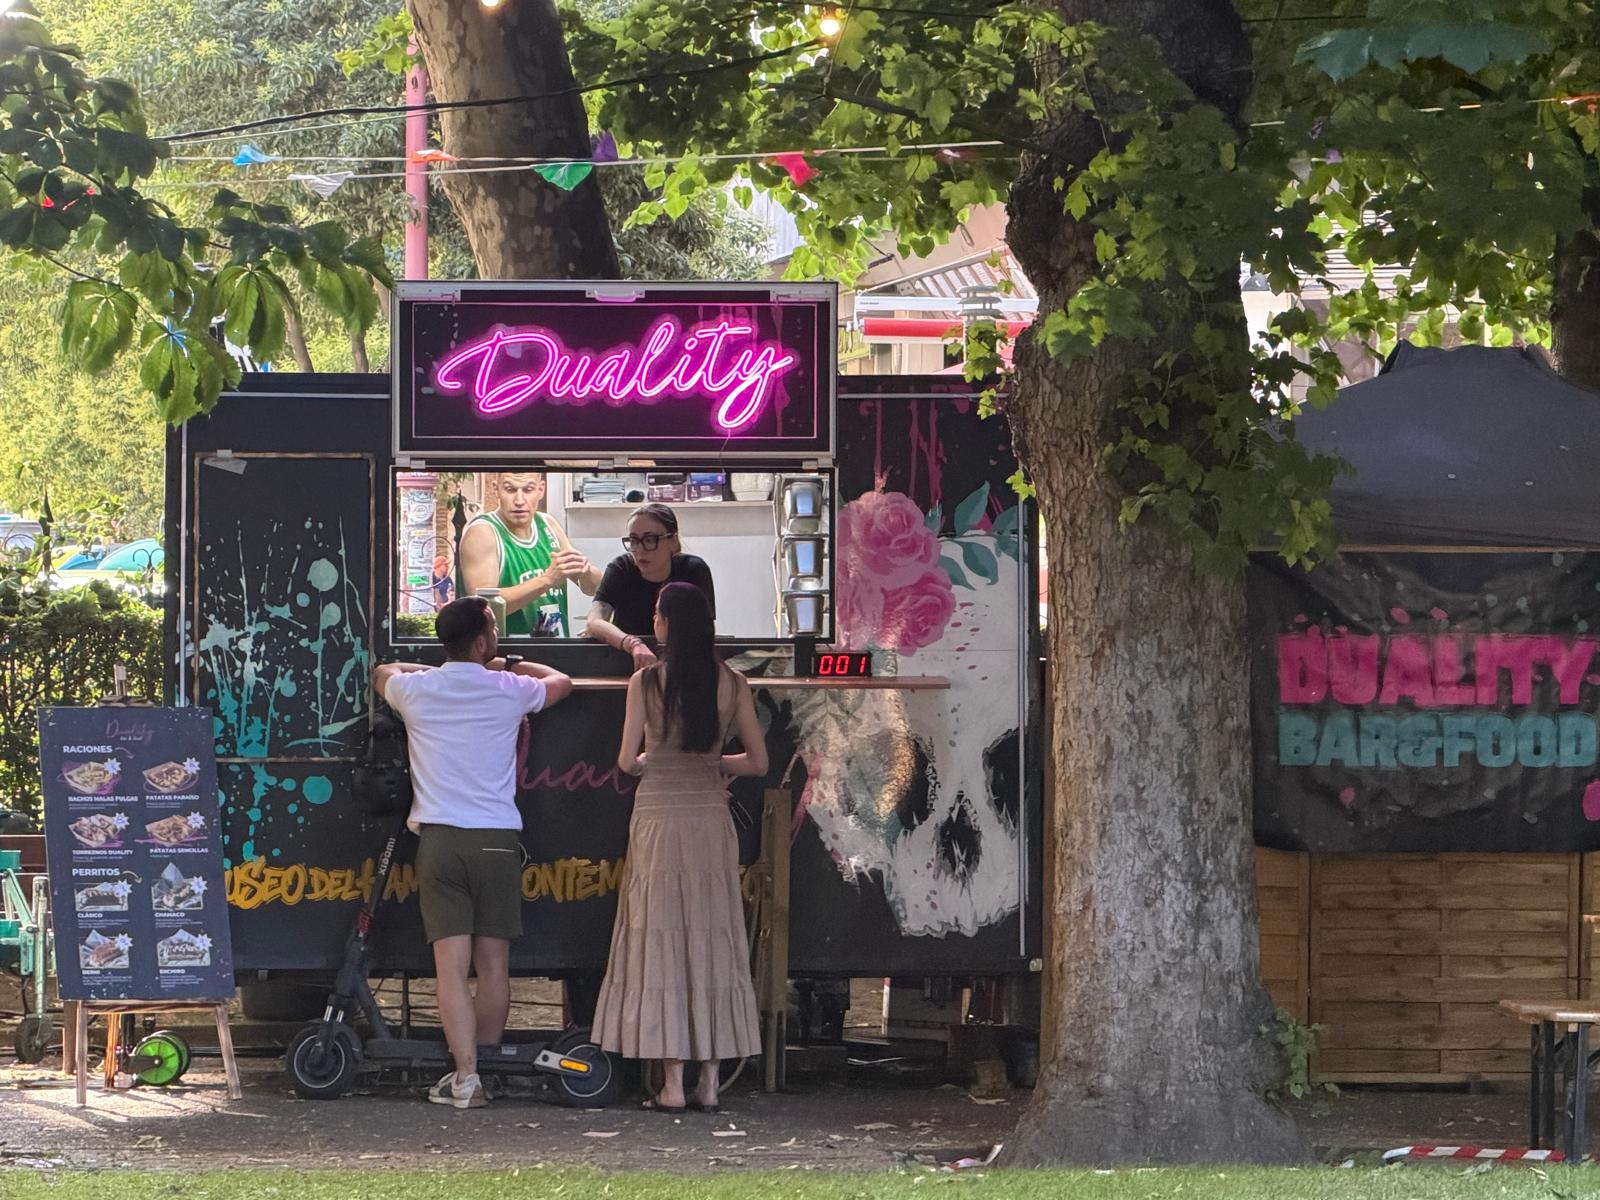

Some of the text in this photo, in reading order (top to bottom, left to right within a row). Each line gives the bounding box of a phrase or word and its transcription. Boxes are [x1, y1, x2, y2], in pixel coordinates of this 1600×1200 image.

[436, 321, 794, 429] Duality
[819, 655, 866, 674] 001
[1278, 632, 1600, 707] DUALITY
[63, 745, 113, 754] RACIONES
[72, 868, 121, 876] PERRITOS
[224, 856, 307, 909] USEO
